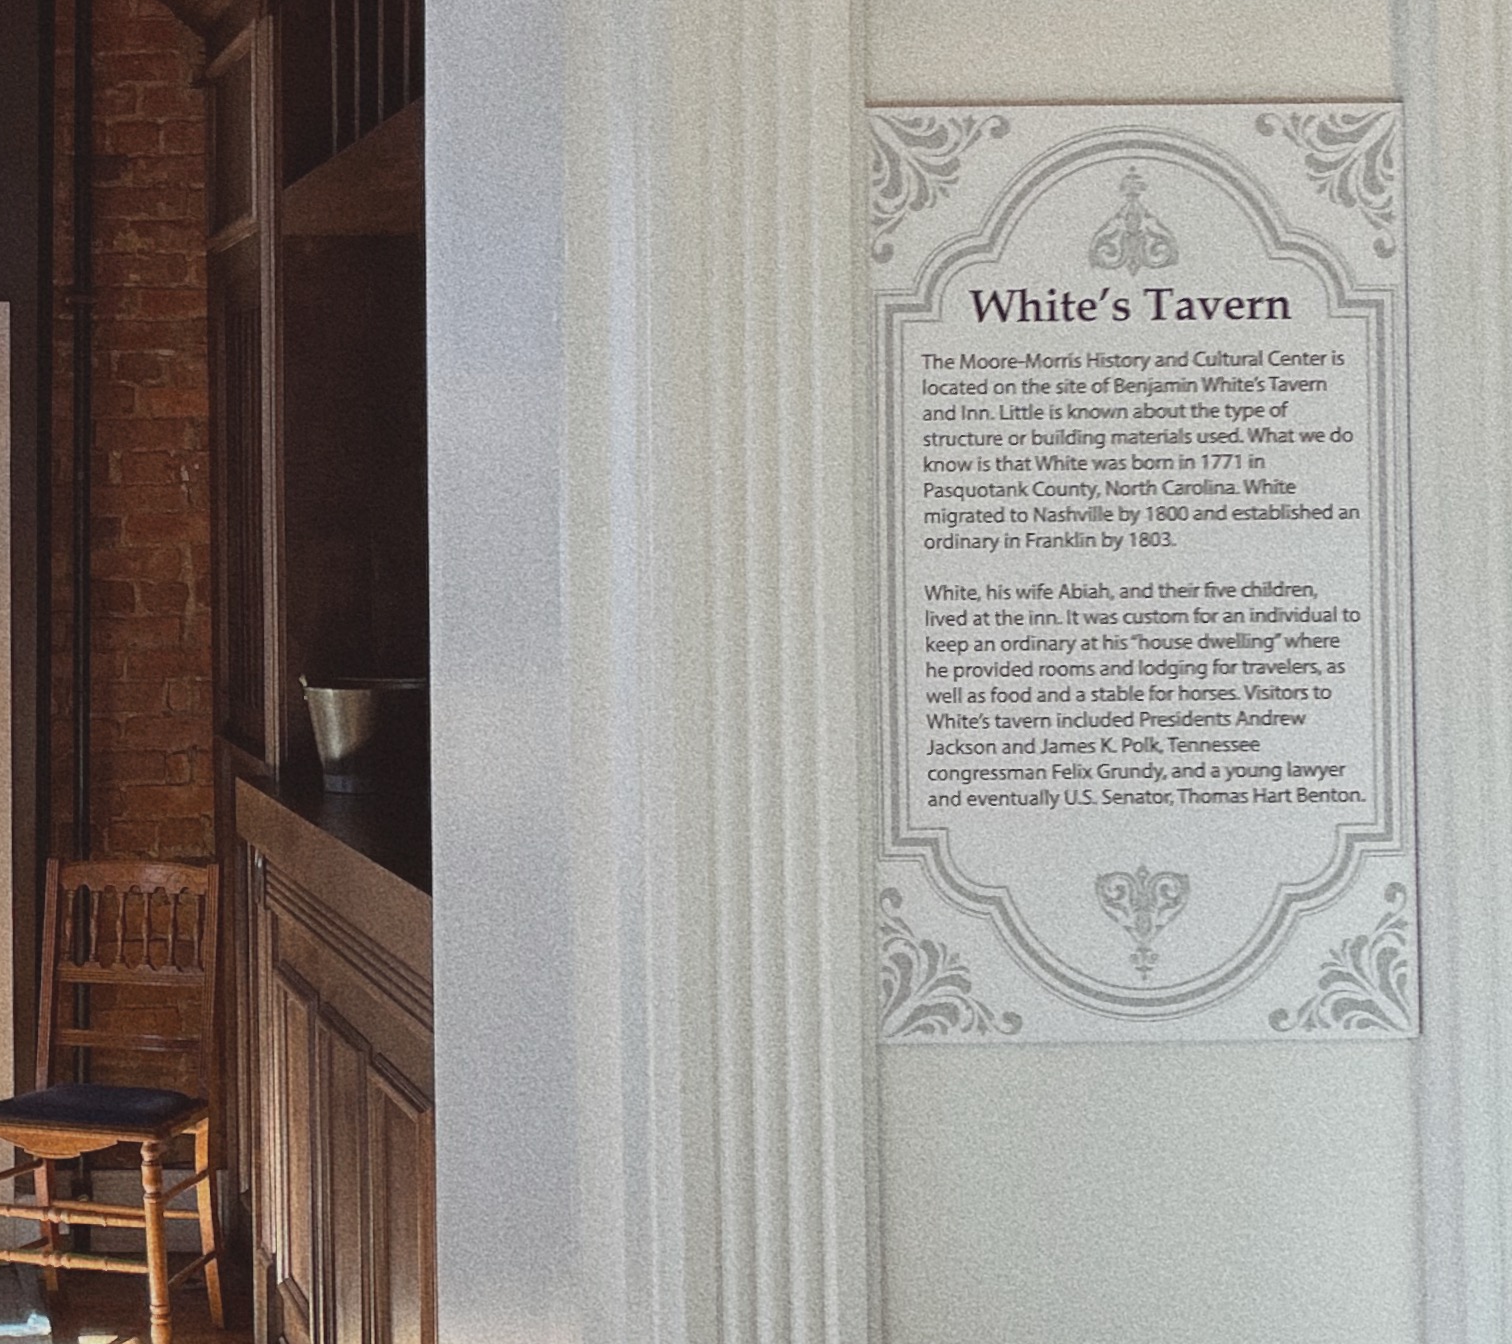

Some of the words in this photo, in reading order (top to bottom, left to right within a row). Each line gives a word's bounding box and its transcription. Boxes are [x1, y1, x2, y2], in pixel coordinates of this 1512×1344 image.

[971, 287, 1131, 323] White's
[1144, 288, 1292, 321] Tavern
[921, 354, 955, 370] The
[1087, 353, 1151, 371] History
[1155, 351, 1189, 367] and
[1192, 350, 1263, 367] Cultural
[1268, 350, 1327, 366] Center
[1331, 350, 1345, 366] is
[922, 379, 988, 395] located
[993, 383, 1016, 394] on
[1021, 378, 1051, 394] the
[1056, 379, 1087, 394] site
[1091, 377, 1111, 394] of
[1114, 378, 1198, 397] Benjamin
[1201, 376, 1265, 392] White's
[1268, 376, 1327, 392] Tavern
[923, 405, 956, 421] and
[961, 405, 995, 420] Inn.
[999, 404, 1044, 420] Little
[1049, 405, 1062, 420] is
[1067, 404, 1128, 419] known
[1133, 403, 1186, 419] about
[1190, 402, 1220, 418] the
[1225, 404, 1265, 422] type
[1269, 401, 1289, 418] of
[923, 432, 1003, 447] structure
[1008, 434, 1027, 446] or
[1031, 429, 1106, 449] building
[1111, 428, 1192, 444] materials
[1197, 428, 1244, 444] used.
[1247, 427, 1295, 443] What
[1299, 431, 1325, 443] we
[1329, 426, 1354, 443] do
[923, 456, 973, 472] know
[978, 457, 991, 472] is
[995, 455, 1031, 471] that
[1035, 455, 1087, 471] White
[1091, 458, 1127, 470] was
[1132, 454, 1174, 470] born
[1179, 454, 1195, 470] in
[1202, 454, 1241, 469] 1771
[1248, 454, 1265, 468] in
[924, 481, 1029, 501] Pasquotank
[1032, 481, 1101, 500] County,
[1106, 480, 1157, 496] North
[1162, 479, 1240, 496] Carolina.
[1243, 478, 1297, 494] White
[924, 506, 1005, 528] migrated
[1010, 509, 1028, 523] to
[1033, 506, 1114, 522] Nashville
[1118, 506, 1141, 526] by
[1146, 506, 1189, 521] 1800
[1193, 505, 1227, 521] and
[1231, 504, 1333, 521] established
[1338, 508, 1360, 520] an
[924, 533, 999, 553] ordinary
[1004, 533, 1020, 548] in
[1026, 532, 1097, 548] Franklin
[1101, 532, 1124, 551] by
[1130, 532, 1176, 547] 1803.
[924, 585, 981, 602] White,
[986, 584, 1011, 600] his
[1016, 583, 1053, 600] wife
[1058, 583, 1115, 600] Abiah,
[1119, 583, 1153, 599] and
[1158, 583, 1200, 598] their
[1204, 581, 1237, 598] five
[1241, 581, 1318, 599] children,
[925, 610, 967, 626] lived
[973, 612, 990, 626] at
[995, 609, 1024, 626] the
[1029, 611, 1063, 625] inn.
[1067, 610, 1079, 625] It
[1083, 612, 1118, 625] was
[1123, 610, 1189, 624] custom
[1193, 607, 1219, 624] for
[1223, 611, 1245, 623] an
[1250, 606, 1337, 623] individual
[1342, 608, 1361, 622] to
[926, 636, 969, 656] keep
[974, 640, 995, 652] an
[1000, 635, 1077, 655] ordinary
[1081, 637, 1098, 651] at
[1102, 634, 1128, 650] his
[1284, 632, 1340, 648] where
[926, 662, 948, 678] he
[953, 661, 1033, 682] provided
[1039, 665, 1096, 677] rooms
[1100, 659, 1134, 676] and
[1138, 659, 1208, 680] lodging
[1213, 658, 1238, 675] for
[1242, 658, 1322, 676] travelers,
[1326, 662, 1346, 674] as
[926, 687, 962, 704] well
[967, 691, 986, 703] as
[990, 686, 1032, 703] food
[1037, 686, 1071, 702] and
[1076, 690, 1086, 702] a
[1091, 685, 1144, 702] stable
[1149, 685, 1174, 701] for
[1178, 685, 1240, 701] horses.
[1244, 685, 1309, 700] Visitors
[1313, 686, 1332, 700] to
[926, 713, 990, 729] White's
[994, 715, 1052, 729] tavern
[1057, 711, 1134, 728] included
[1140, 710, 1231, 727] Presidents
[1235, 709, 1306, 726] Andrew
[927, 739, 997, 755] Jackson
[1002, 738, 1036, 754] and
[1040, 738, 1096, 754] James
[1101, 737, 1117, 753] K.
[1122, 737, 1164, 754] Polk,
[1167, 736, 1260, 753] Tennessee
[928, 768, 1047, 785] congressman
[1052, 763, 1093, 780] Felix
[1097, 762, 1167, 782] Grundy,
[1171, 762, 1205, 778] and
[1210, 766, 1220, 778] a
[1224, 765, 1282, 782] young
[1287, 761, 1346, 781] lawyer
[928, 790, 961, 807] and
[966, 789, 1060, 810] eventually
[1064, 789, 1097, 805] U.S.
[1102, 789, 1174, 806] Senator,
[1177, 788, 1249, 804] Thomas
[1253, 788, 1292, 803] Hart
[1296, 787, 1366, 803] Benton.
